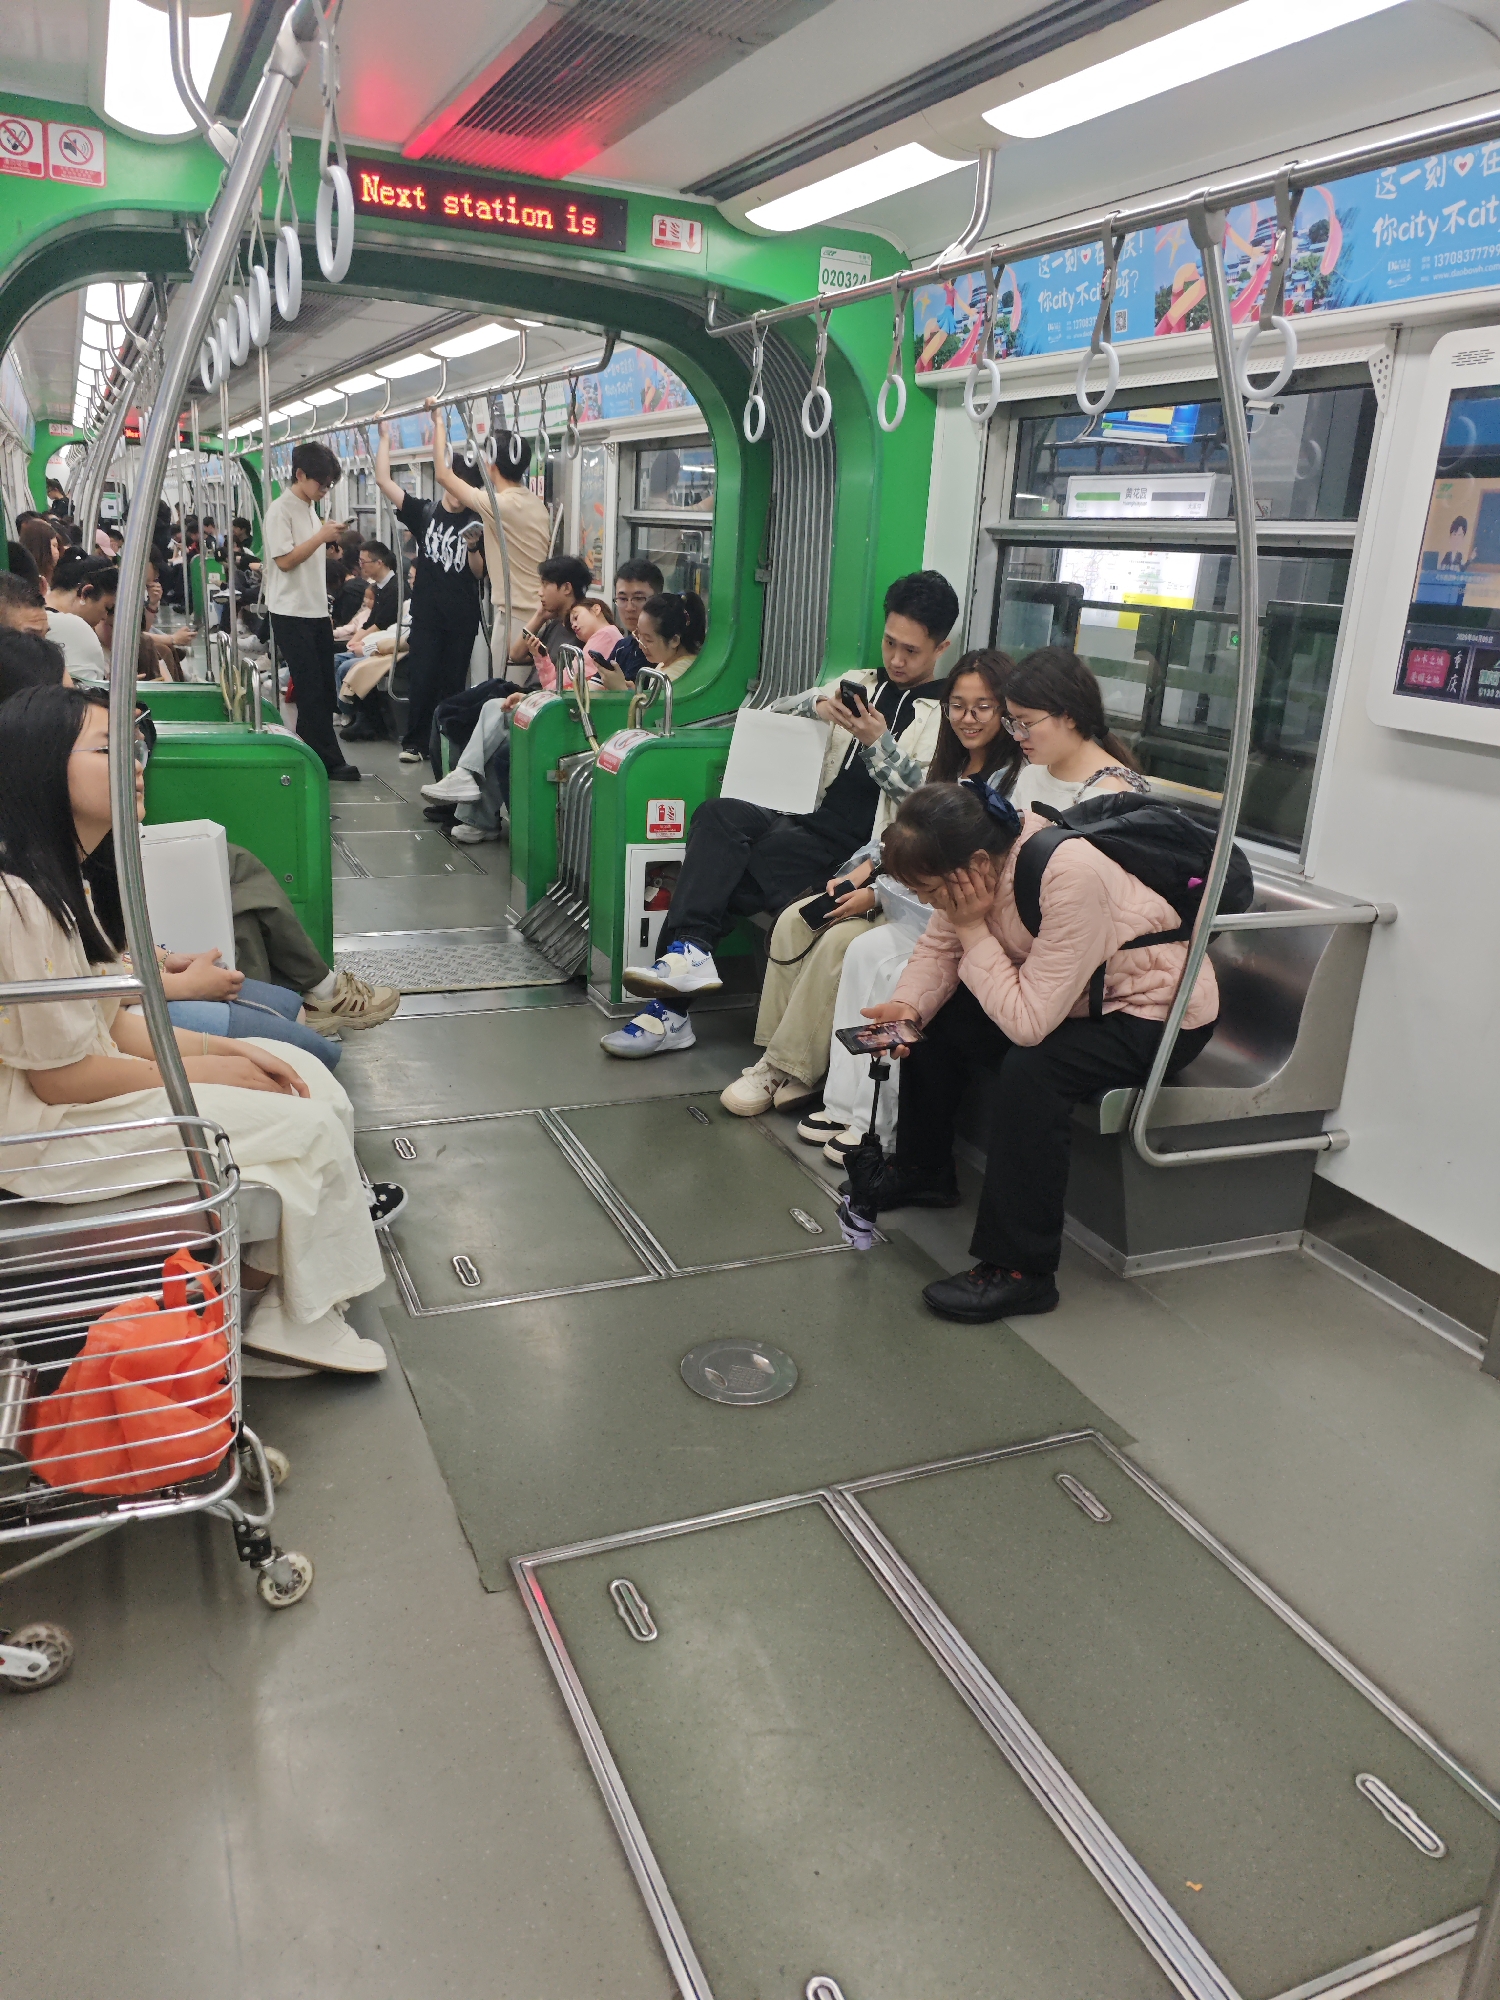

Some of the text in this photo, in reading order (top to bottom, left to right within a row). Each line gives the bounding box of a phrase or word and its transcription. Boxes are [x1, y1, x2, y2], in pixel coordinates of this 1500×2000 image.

[1375, 154, 1447, 199] 这一刻
[360, 173, 597, 235] Next station is
[1372, 195, 1500, 248] 你city不cit
[1125, 487, 1148, 500] 黄花园
